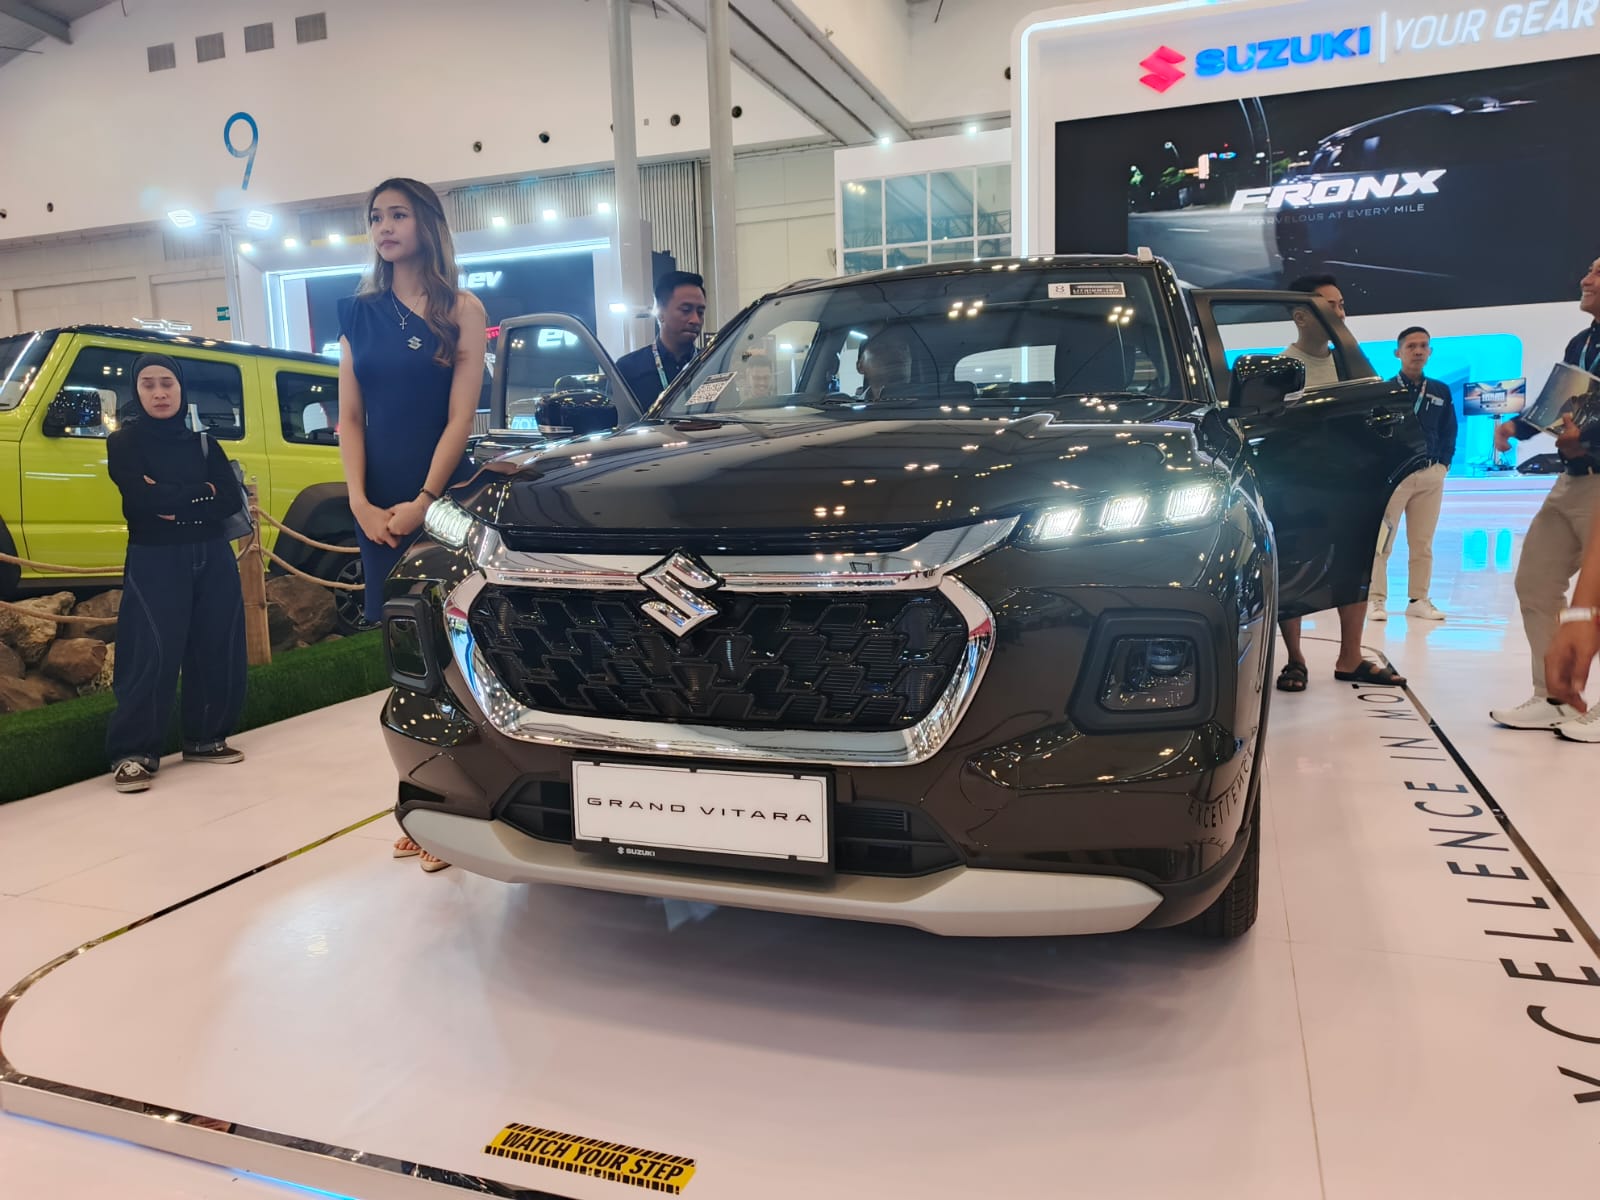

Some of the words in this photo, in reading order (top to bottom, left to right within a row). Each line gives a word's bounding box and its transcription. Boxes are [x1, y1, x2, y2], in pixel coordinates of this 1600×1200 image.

[1195, 26, 1371, 77] SUZUKI
[1393, 9, 1486, 51] YOUR
[1494, 0, 1599, 39] GEAR
[223, 111, 259, 191] 9
[1229, 169, 1447, 212] FRONX
[1250, 212, 1324, 225] MARVELOUS
[1328, 211, 1342, 219] AT
[1347, 206, 1390, 218] EVERY
[1394, 203, 1425, 213] MILE
[1379, 735, 1447, 762] IN
[587, 797, 685, 813] GRAND
[700, 806, 812, 823] VITARA
[625, 848, 656, 857] SUZUKI
[503, 1131, 572, 1158] WATCH
[574, 1146, 628, 1171] YOUR
[629, 1158, 684, 1182] STEP
